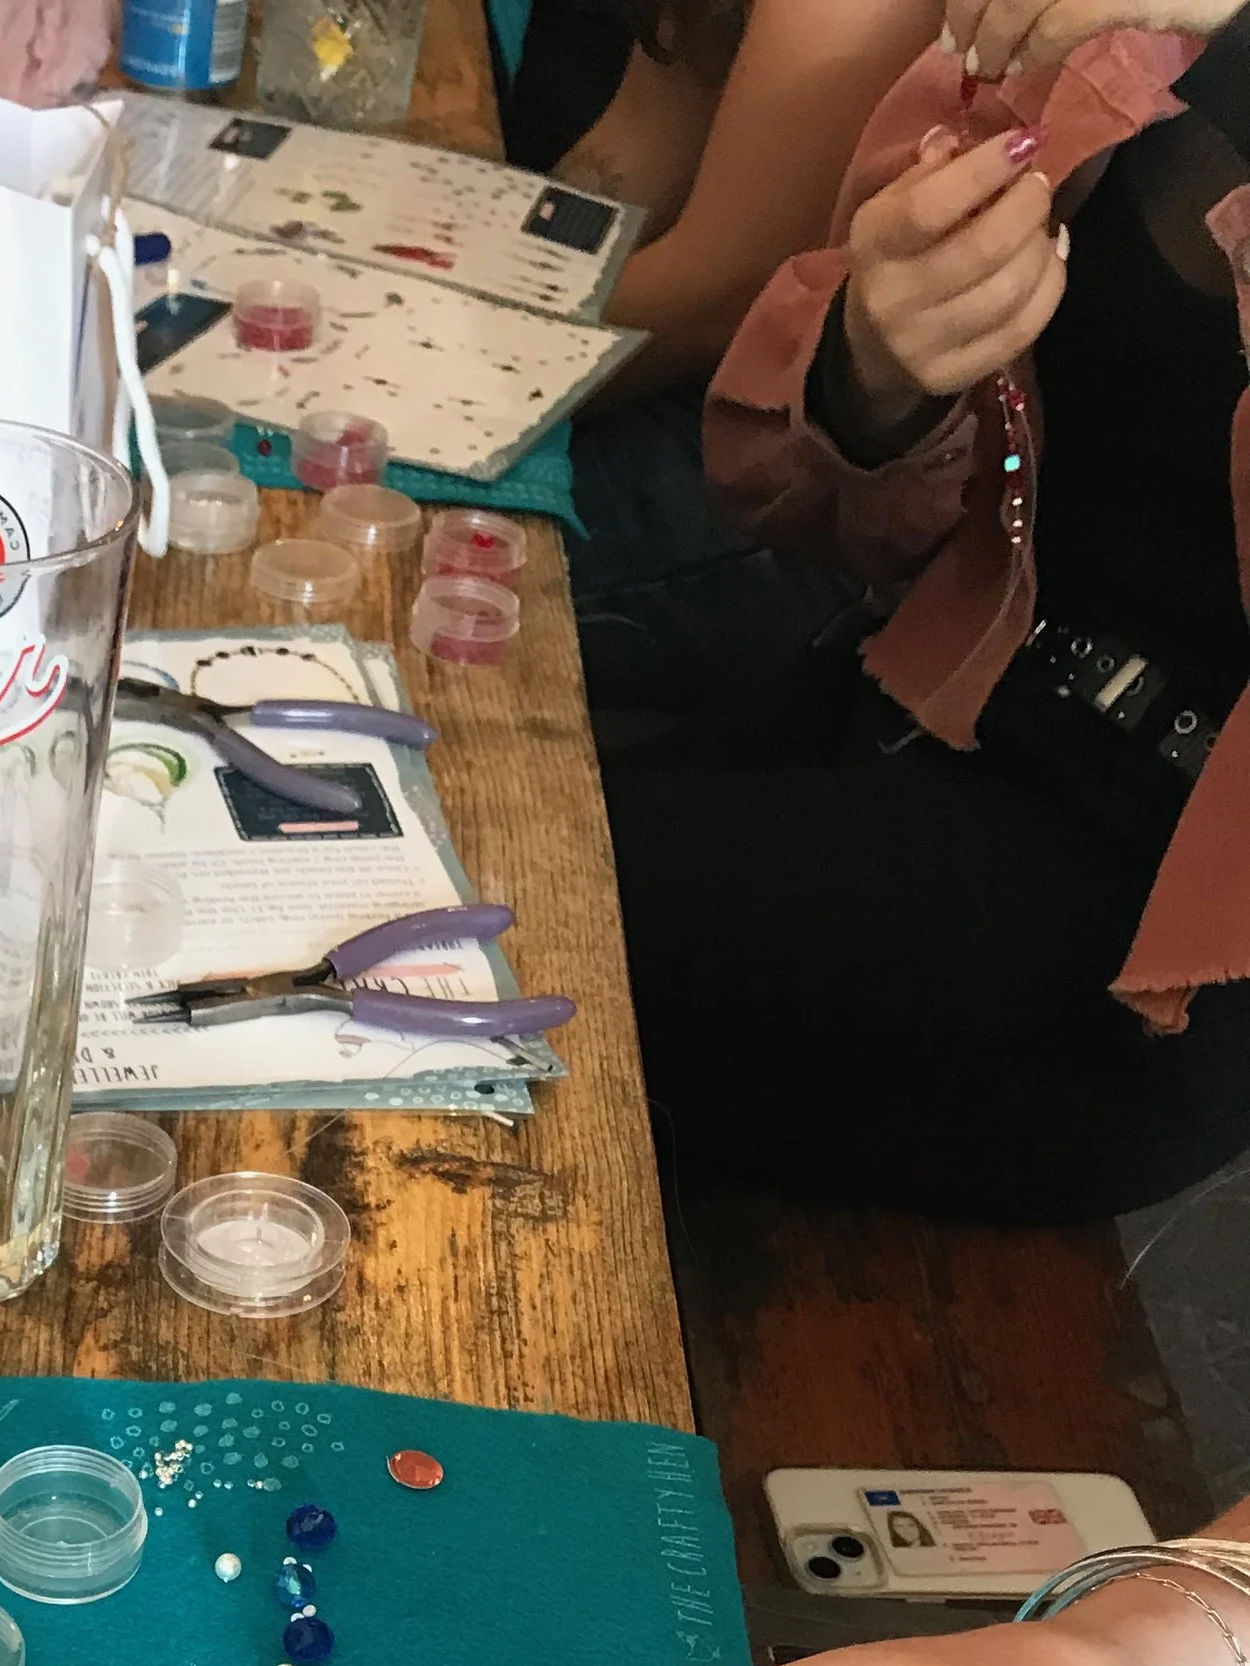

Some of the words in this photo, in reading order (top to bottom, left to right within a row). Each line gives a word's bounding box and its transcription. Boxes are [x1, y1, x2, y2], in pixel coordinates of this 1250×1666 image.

[73, 1064, 158, 1085] JEWELLE
[646, 1441, 693, 1482] HEN
[653, 1488, 707, 1576] CRAFTY
[670, 1581, 714, 1626] THE
